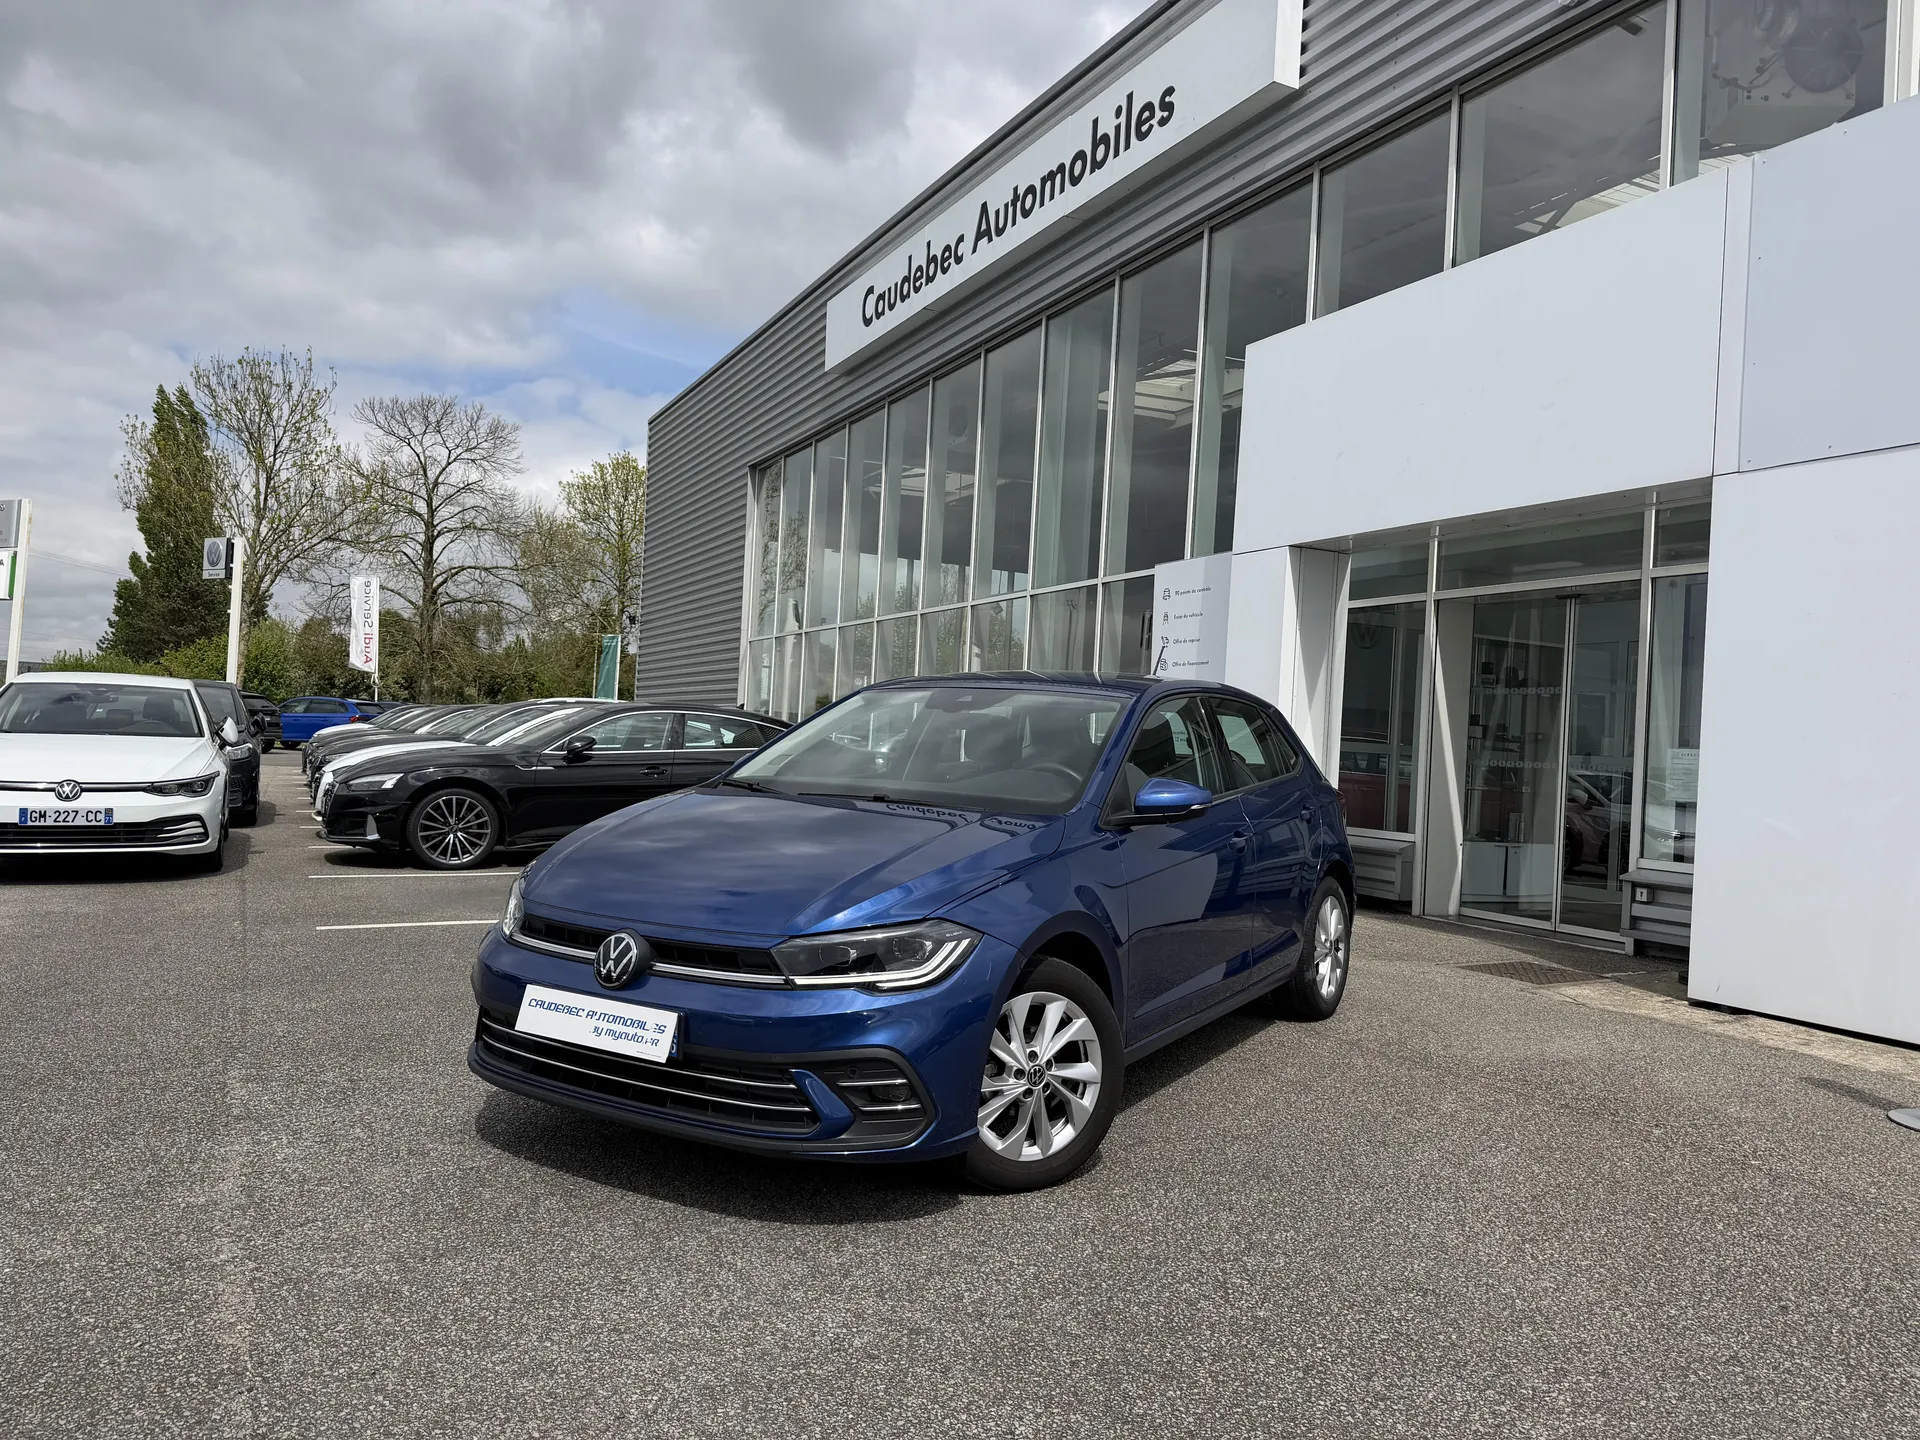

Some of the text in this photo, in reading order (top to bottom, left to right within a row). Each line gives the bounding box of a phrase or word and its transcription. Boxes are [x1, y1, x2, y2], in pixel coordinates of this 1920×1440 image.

[861, 85, 1176, 328] Caudebec Automobiles
[29, 810, 102, 823] GM-227-CC
[528, 998, 585, 1017] CAUDEBEC
